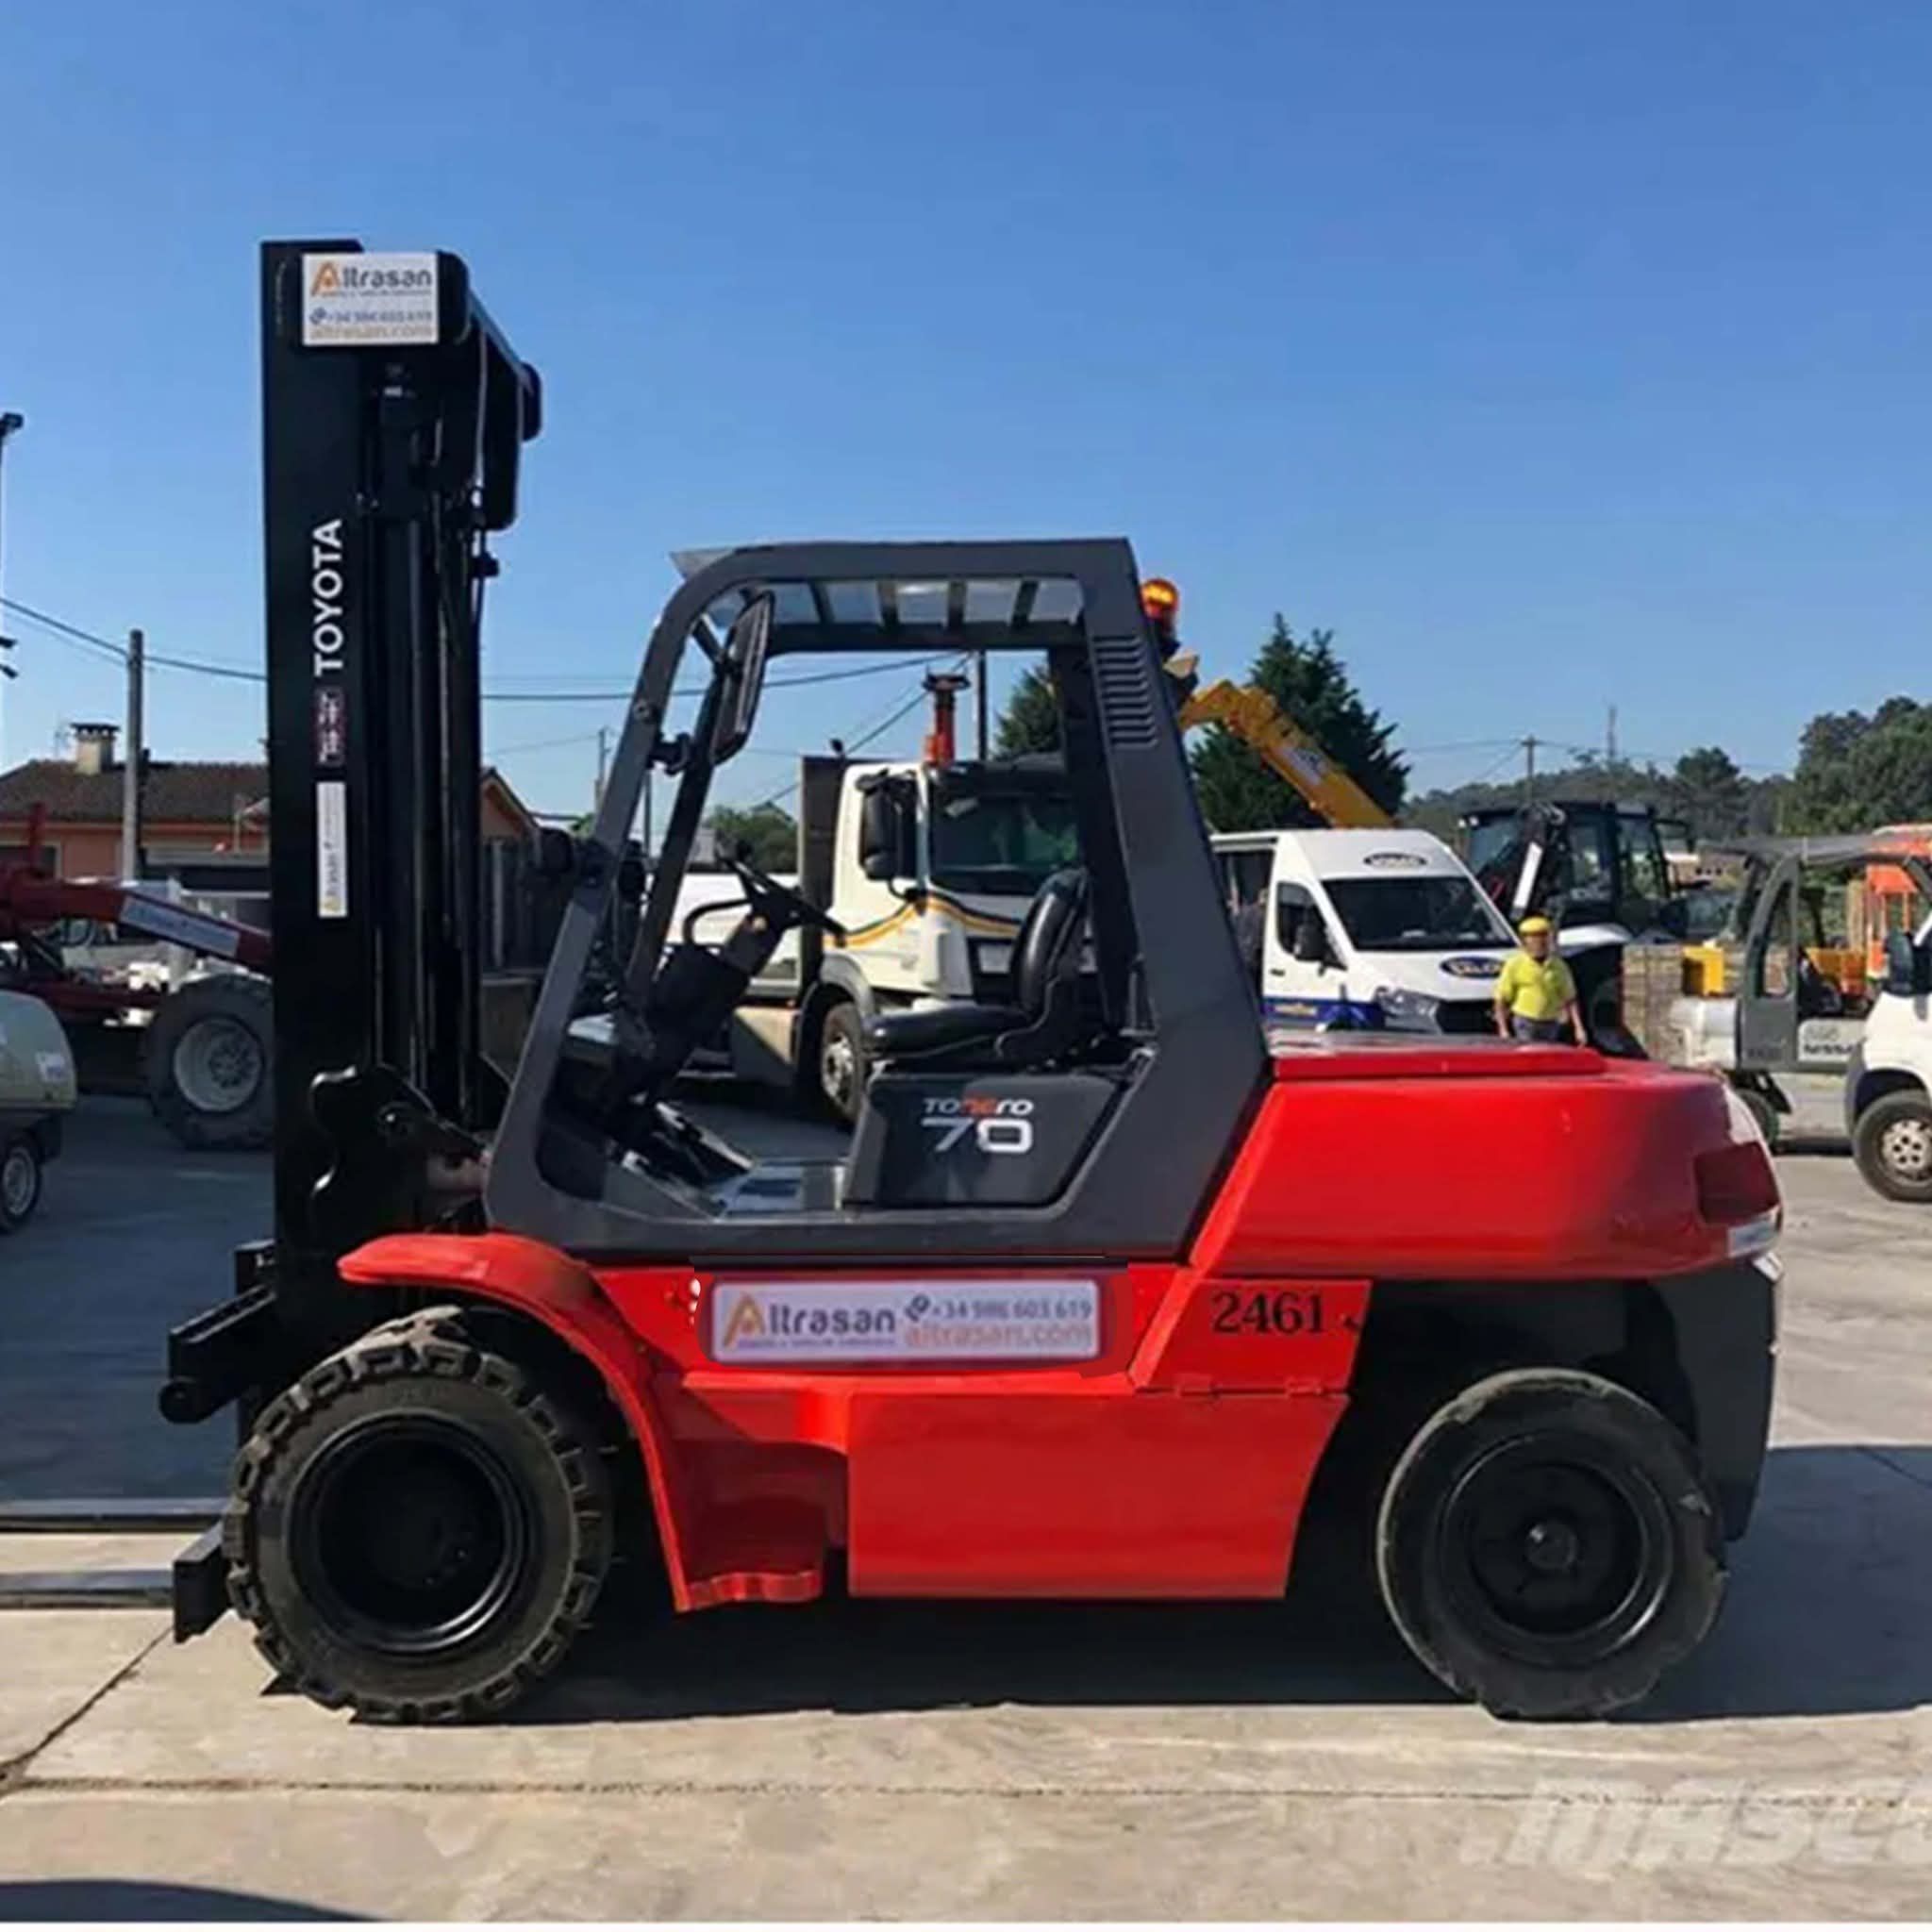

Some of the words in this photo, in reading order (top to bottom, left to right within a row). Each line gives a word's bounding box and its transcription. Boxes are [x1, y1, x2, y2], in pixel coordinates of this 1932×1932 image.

[311, 261, 432, 296] Altrasan
[311, 519, 343, 676] TOYOTA
[921, 1117, 1033, 1153] 70
[723, 1292, 895, 1349] Altrasan
[1211, 1291, 1324, 1334] 2461
